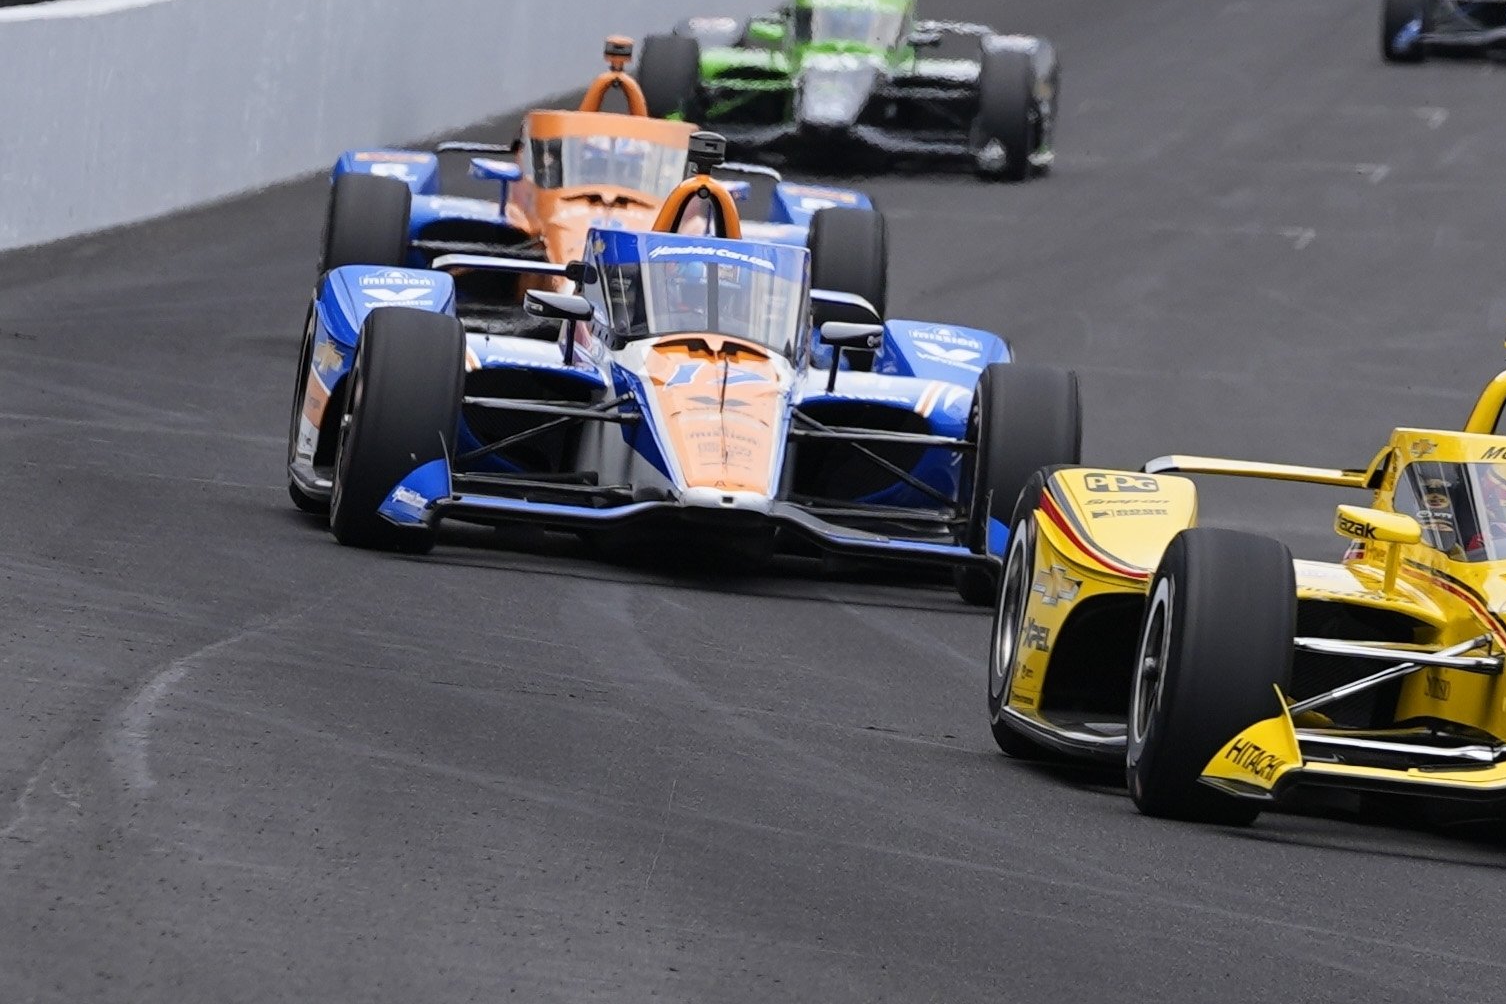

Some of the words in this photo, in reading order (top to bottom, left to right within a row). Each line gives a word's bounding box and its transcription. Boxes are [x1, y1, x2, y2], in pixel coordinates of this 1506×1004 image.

[362, 277, 431, 285] mission
[1086, 474, 1157, 491] PPG
[1225, 737, 1287, 781] HITACHI
